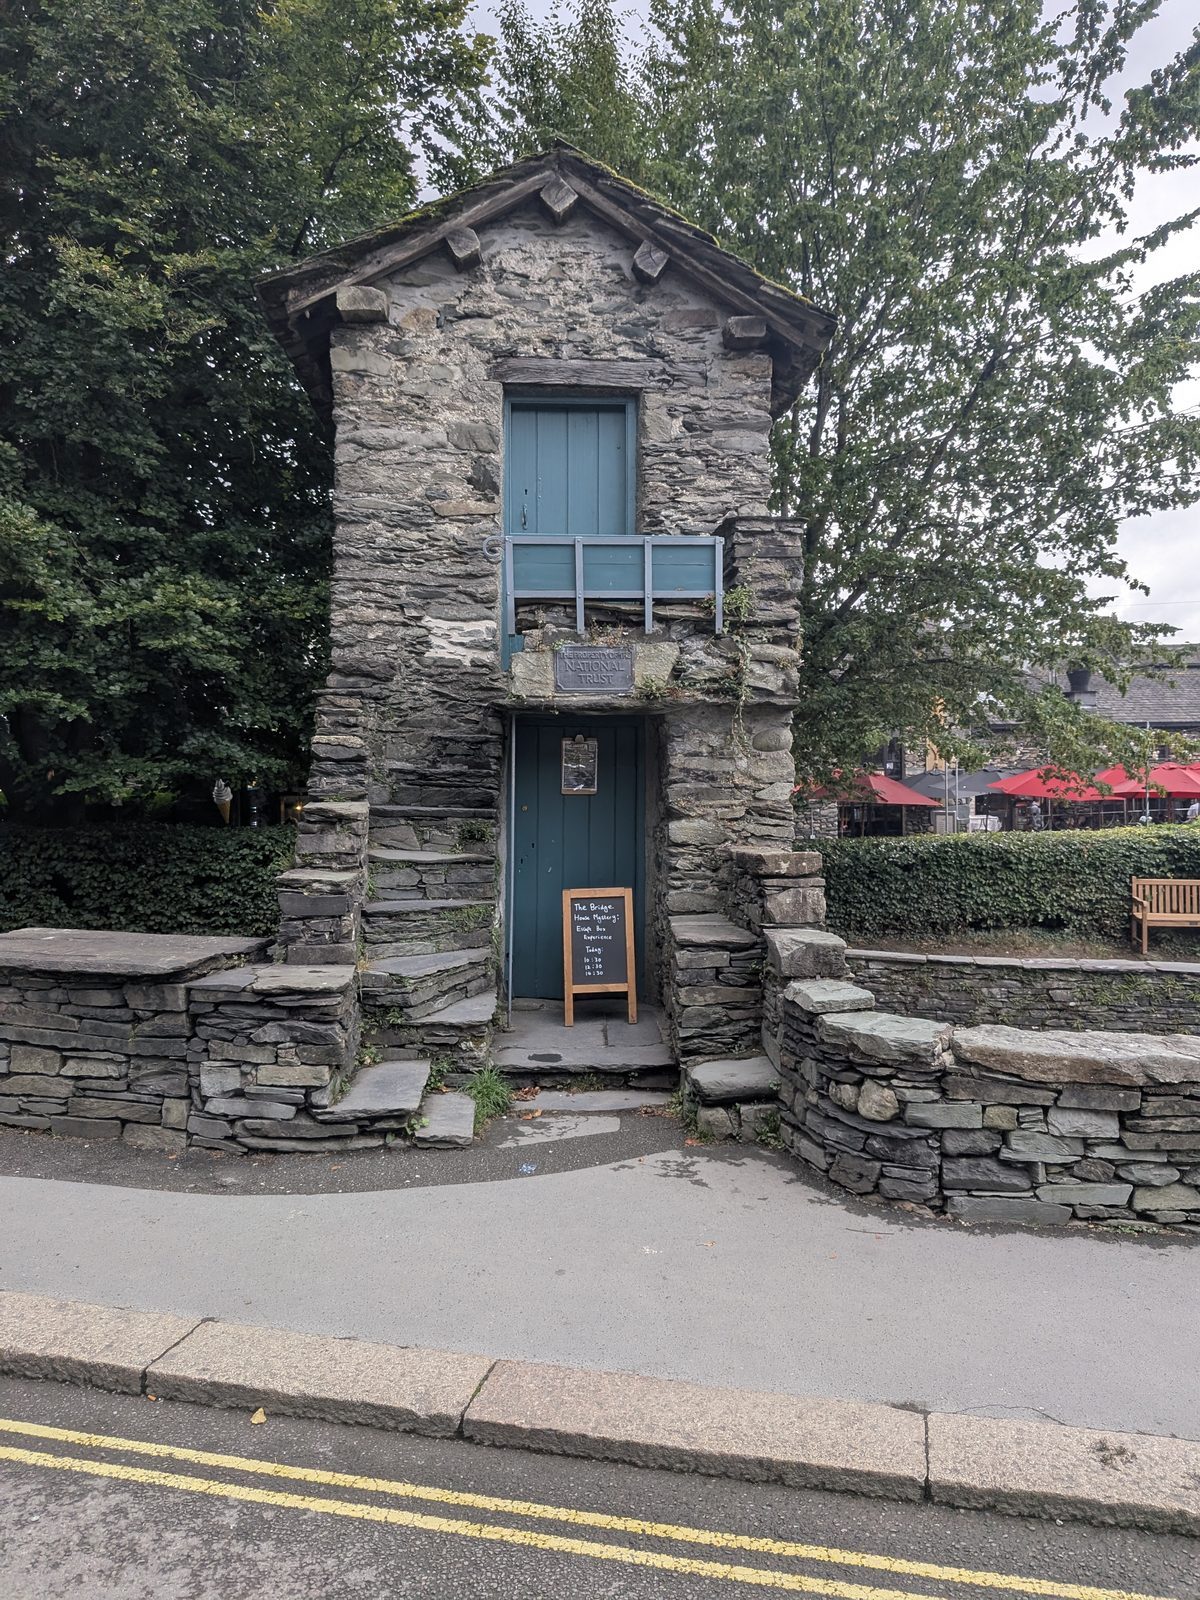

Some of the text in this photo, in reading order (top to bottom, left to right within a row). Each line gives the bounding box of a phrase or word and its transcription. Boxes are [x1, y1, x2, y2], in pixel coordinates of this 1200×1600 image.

[565, 660, 624, 672] NATIONAL
[578, 674, 614, 685] TRUST
[574, 903, 614, 913] The Bridge
[593, 914, 620, 924] Mystery:
[596, 924, 606, 932] Box
[583, 934, 613, 942] Experience
[585, 945, 604, 955] Today:
